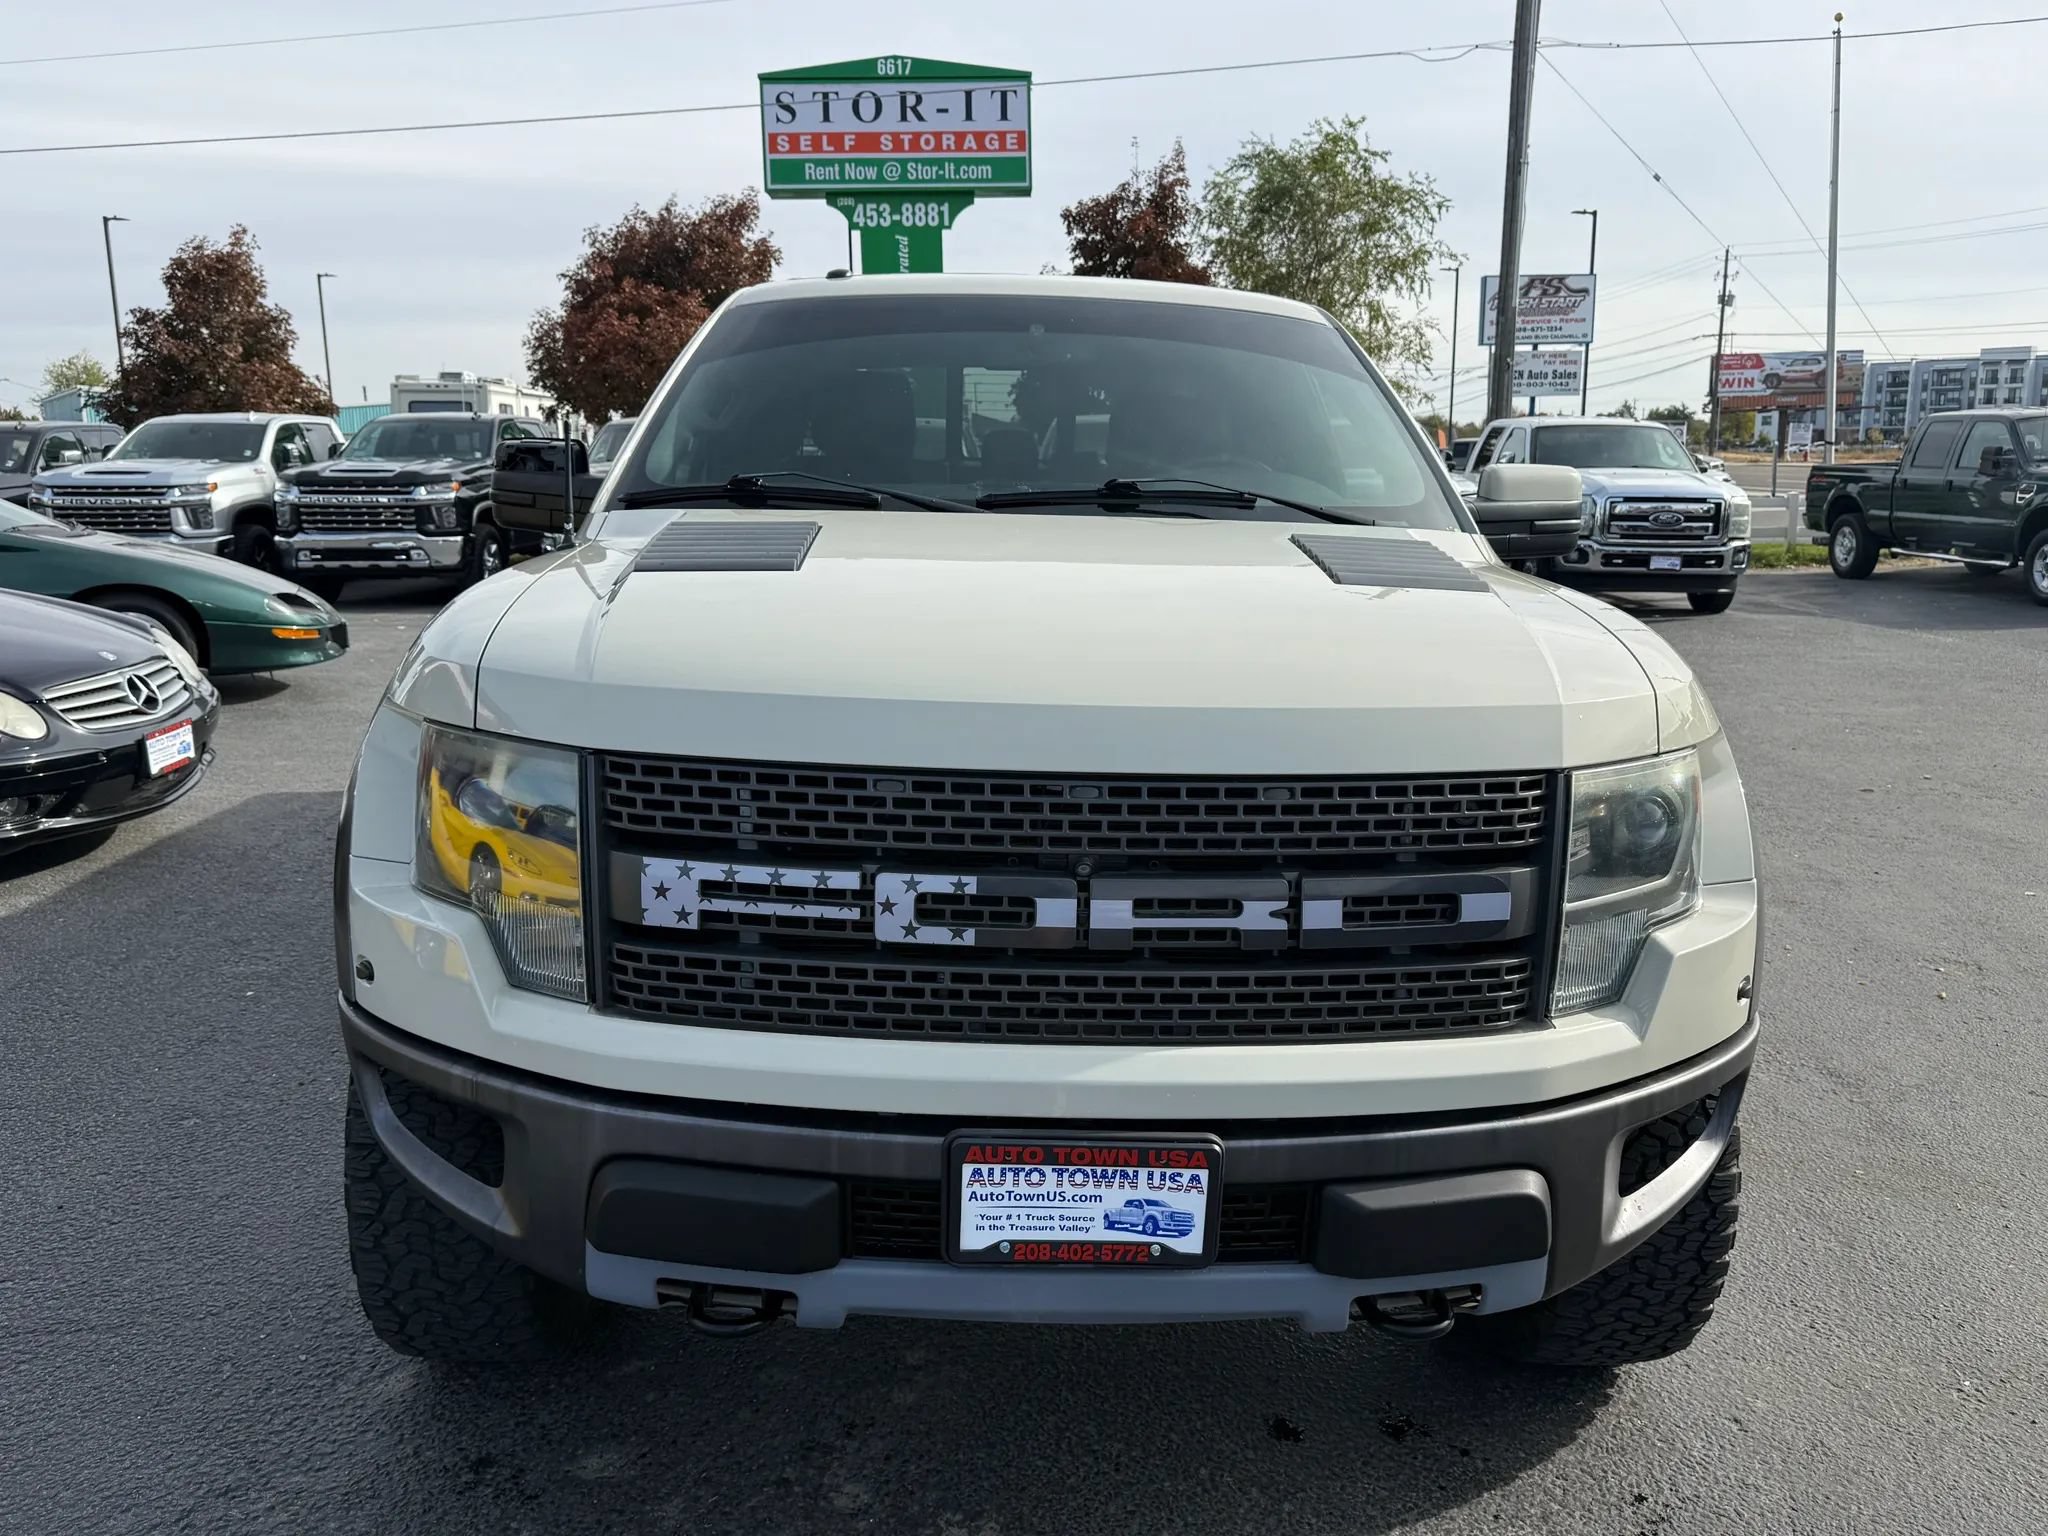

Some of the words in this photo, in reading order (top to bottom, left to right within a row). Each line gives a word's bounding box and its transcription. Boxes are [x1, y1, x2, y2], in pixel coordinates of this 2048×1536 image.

[877, 59, 912, 75] 6617
[775, 89, 1018, 124] STOR-IT
[776, 135, 856, 151] SELF
[880, 133, 1019, 151] STORAGE
[805, 163, 840, 180] Rent
[845, 163, 877, 180] Now
[883, 162, 900, 180] @
[907, 162, 992, 180] Stor-It.com
[853, 202, 950, 227] 453-8881
[1527, 369, 1549, 380] Auto
[1552, 368, 1577, 380] Sales
[1719, 377, 1755, 388] WIN
[641, 856, 1511, 950] FORD
[965, 1145, 1044, 1162] AUTO
[1053, 1146, 1138, 1167] TOWN
[1148, 1149, 1208, 1168] USA
[966, 1167, 1046, 1188] AUTO
[1052, 1167, 1139, 1190] TOWN
[1147, 1170, 1205, 1195] USA
[968, 1190, 1103, 1204] AutoTownUS.com
[1025, 1213, 1055, 1221] Truck
[1058, 1214, 1095, 1222] Source
[1009, 1224, 1055, 1232] Treasure
[1013, 1243, 1150, 1262] 208-402-5772
